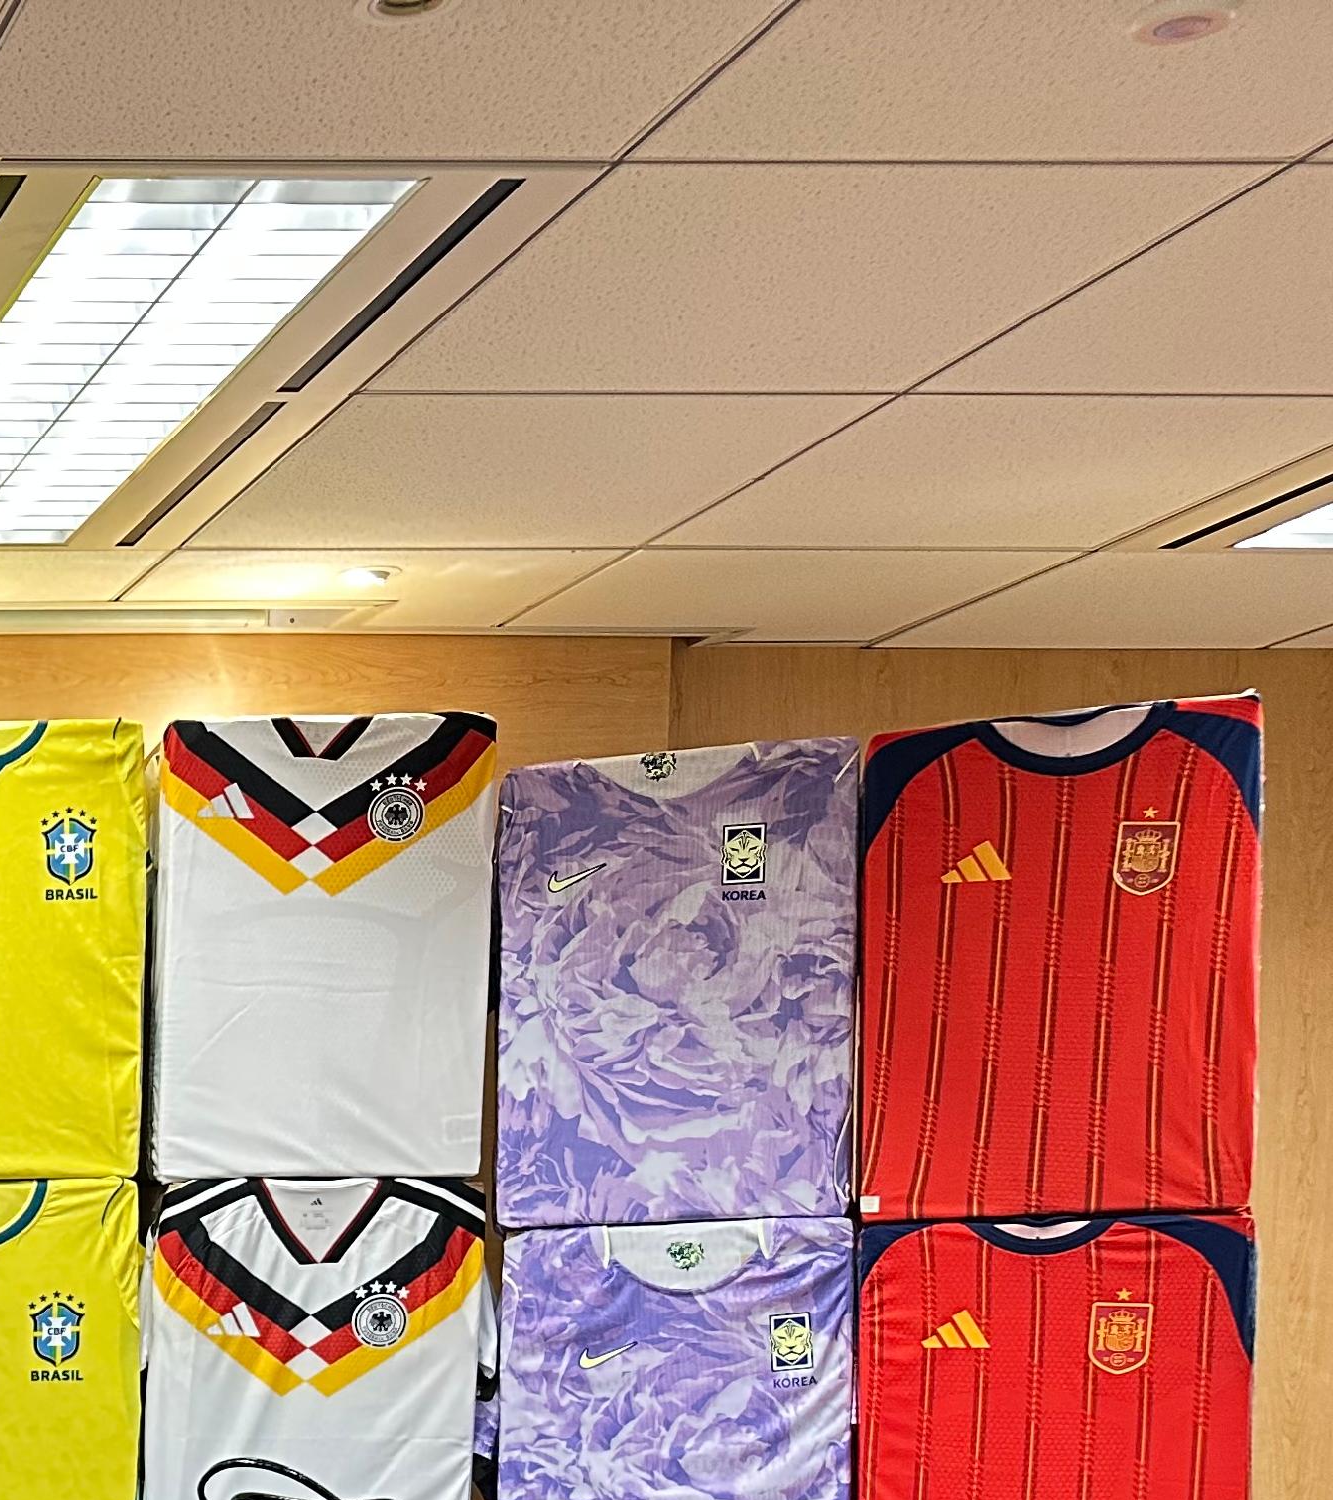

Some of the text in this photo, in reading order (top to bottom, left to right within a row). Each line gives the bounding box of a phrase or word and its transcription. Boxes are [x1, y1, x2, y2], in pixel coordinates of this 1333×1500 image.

[60, 844, 79, 853] CBF
[45, 888, 98, 901] BRASIL
[722, 890, 767, 901] KOREA
[47, 1327, 66, 1336] CBF
[30, 1370, 83, 1381] BRASIL
[773, 1375, 818, 1388] KOREA
